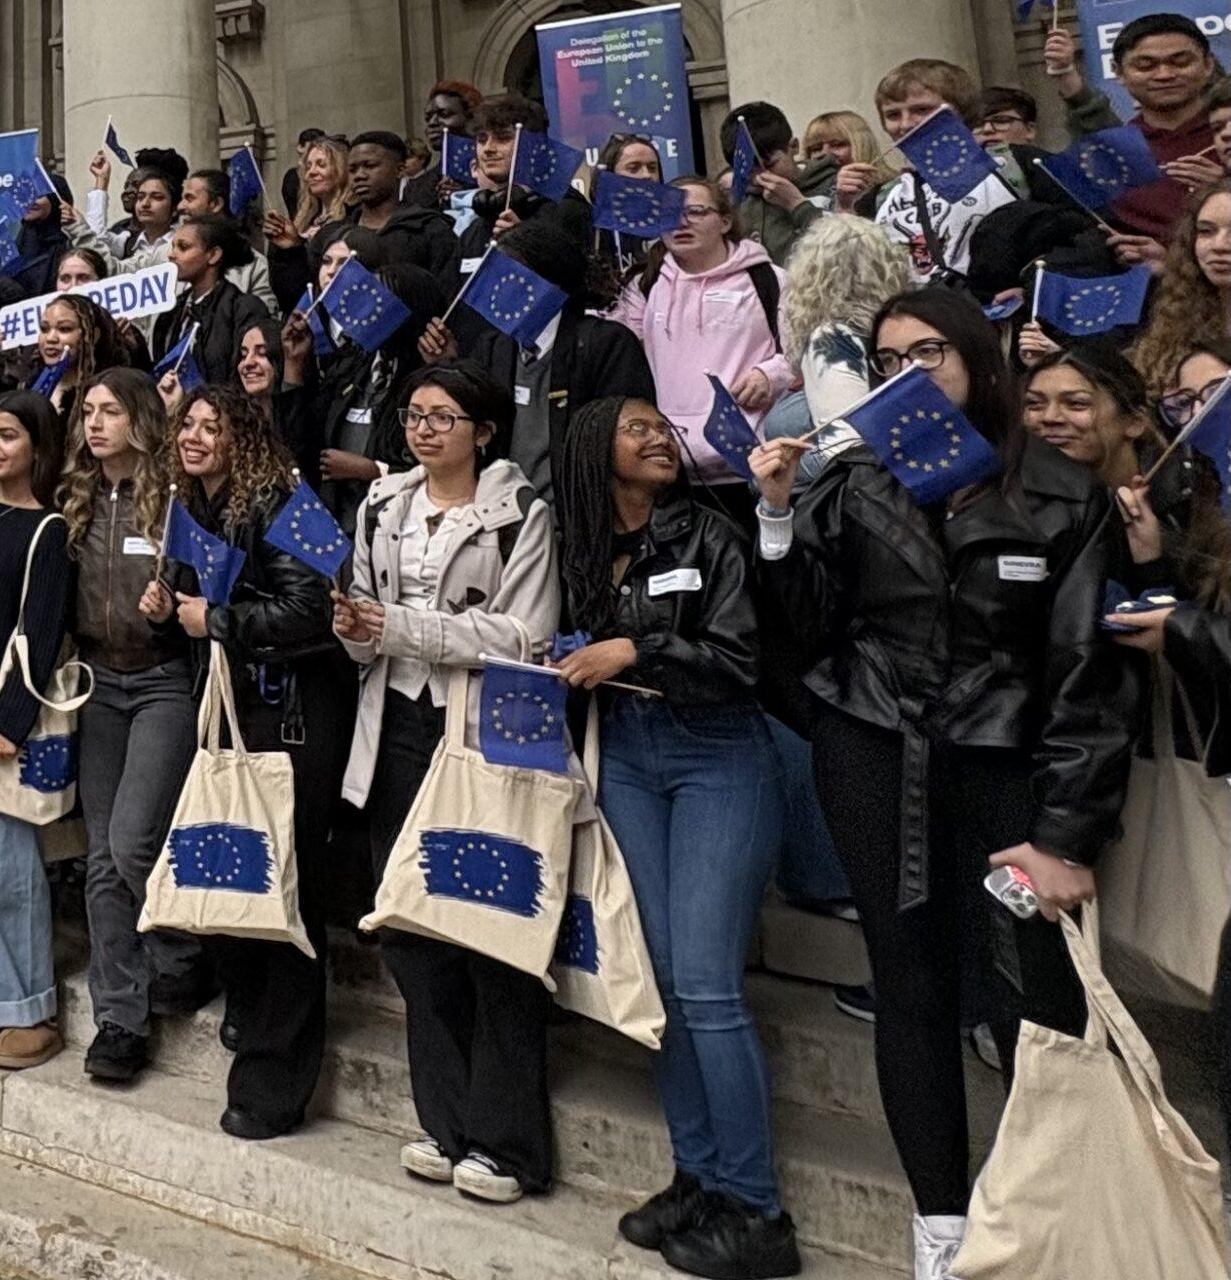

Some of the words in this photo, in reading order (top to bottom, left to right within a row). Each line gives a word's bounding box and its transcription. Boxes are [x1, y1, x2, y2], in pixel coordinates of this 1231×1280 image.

[570, 33, 620, 47] Delegation
[620, 30, 630, 40] of
[631, 28, 647, 38] the
[556, 46, 603, 59] European
[605, 40, 635, 52] Union
[636, 39, 646, 48] to
[647, 37, 663, 46] the
[571, 55, 603, 68] United
[605, 49, 650, 63] Kingdom
